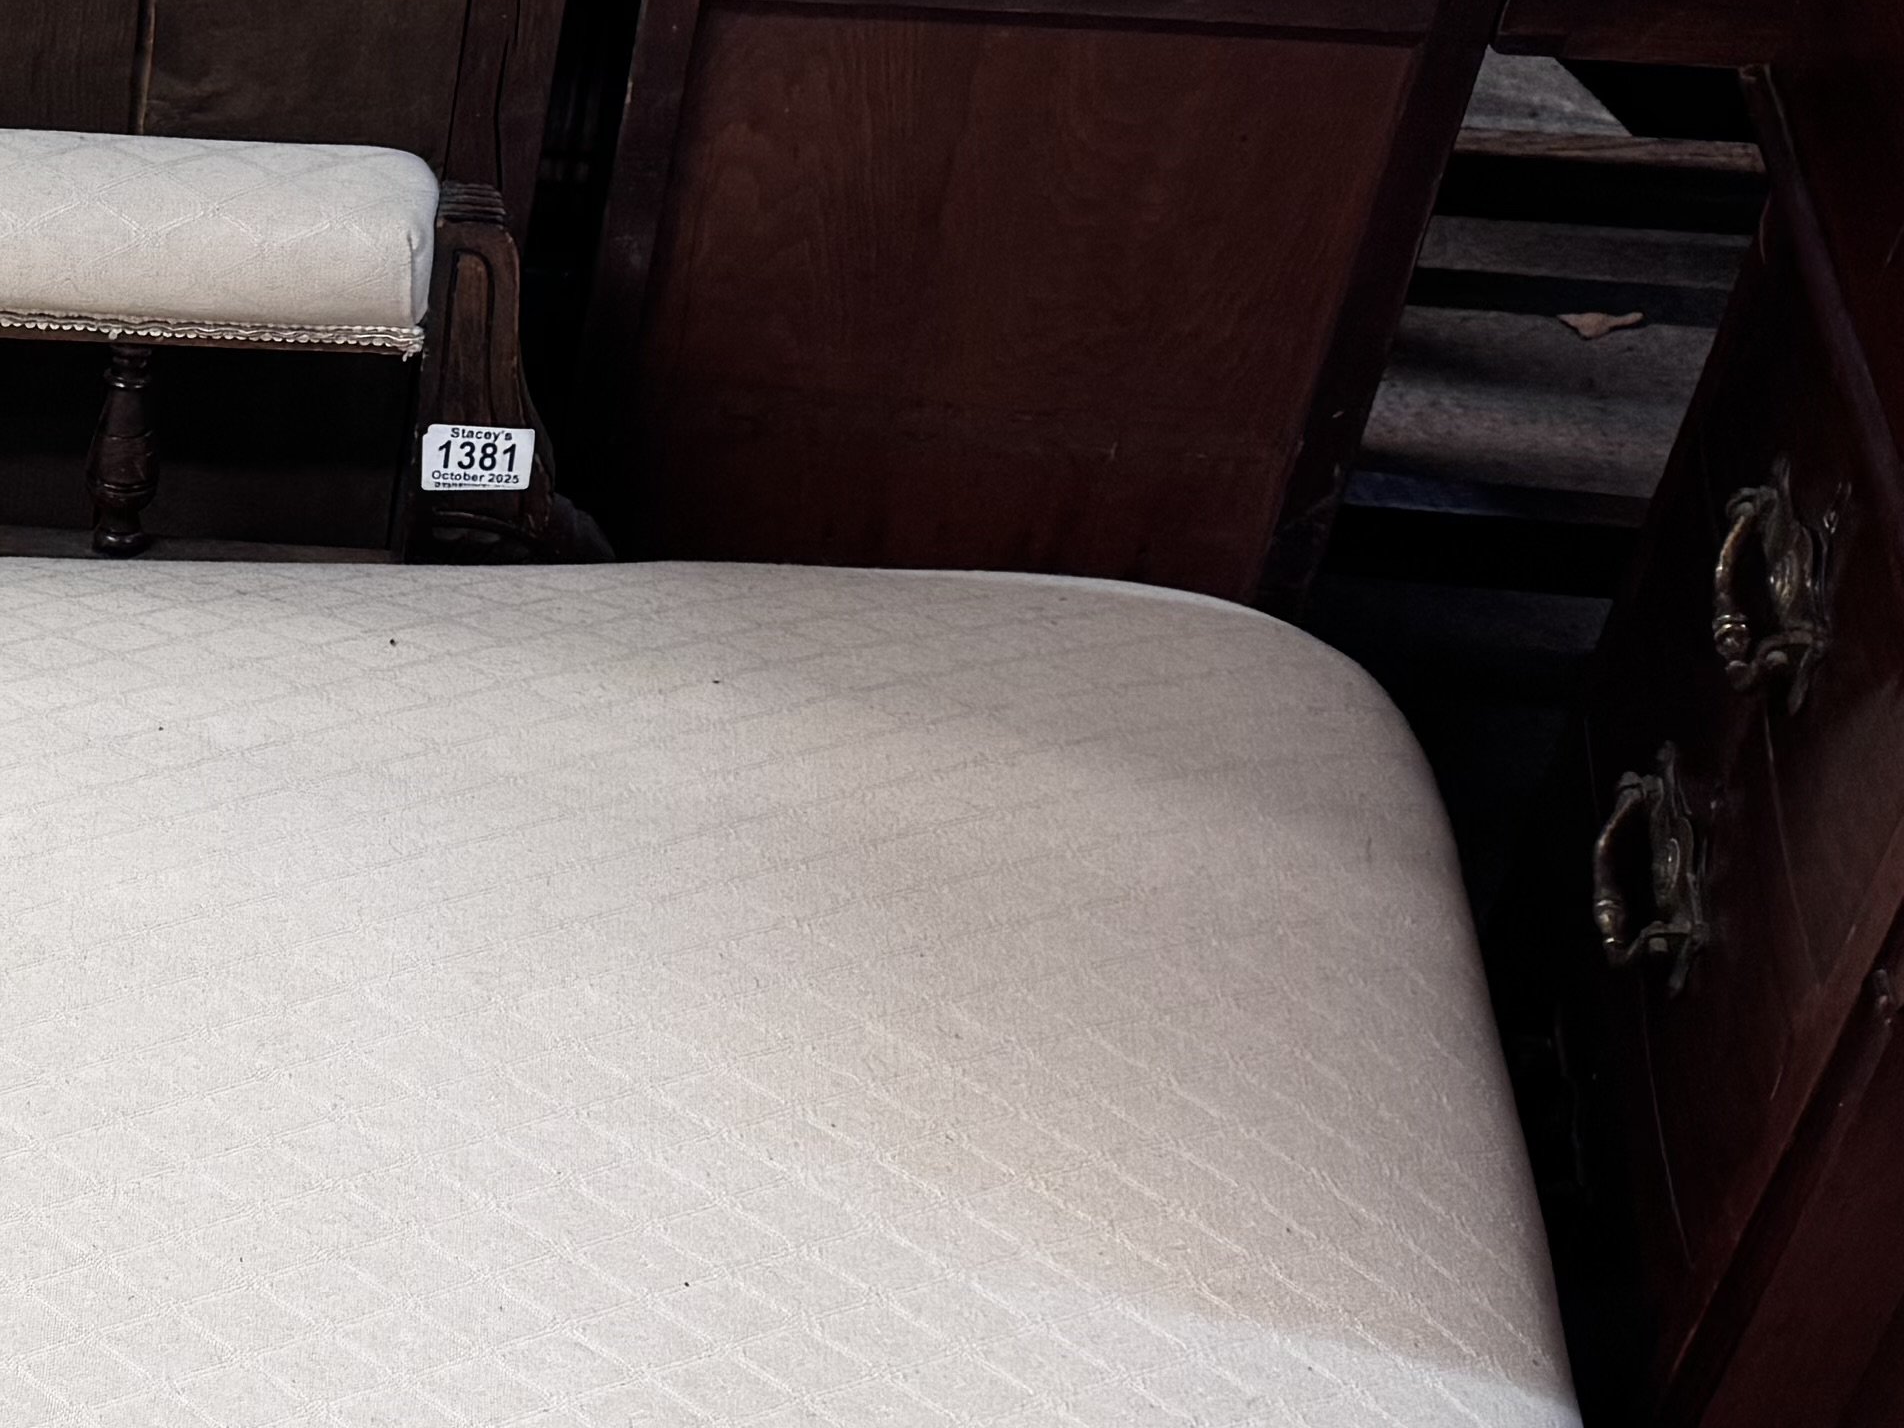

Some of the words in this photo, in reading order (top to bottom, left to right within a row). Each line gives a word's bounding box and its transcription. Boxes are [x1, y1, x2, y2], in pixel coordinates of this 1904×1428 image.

[451, 428, 512, 442] Stacey's
[438, 440, 516, 472] 1381
[432, 470, 484, 482] October
[488, 473, 519, 483] 2025
